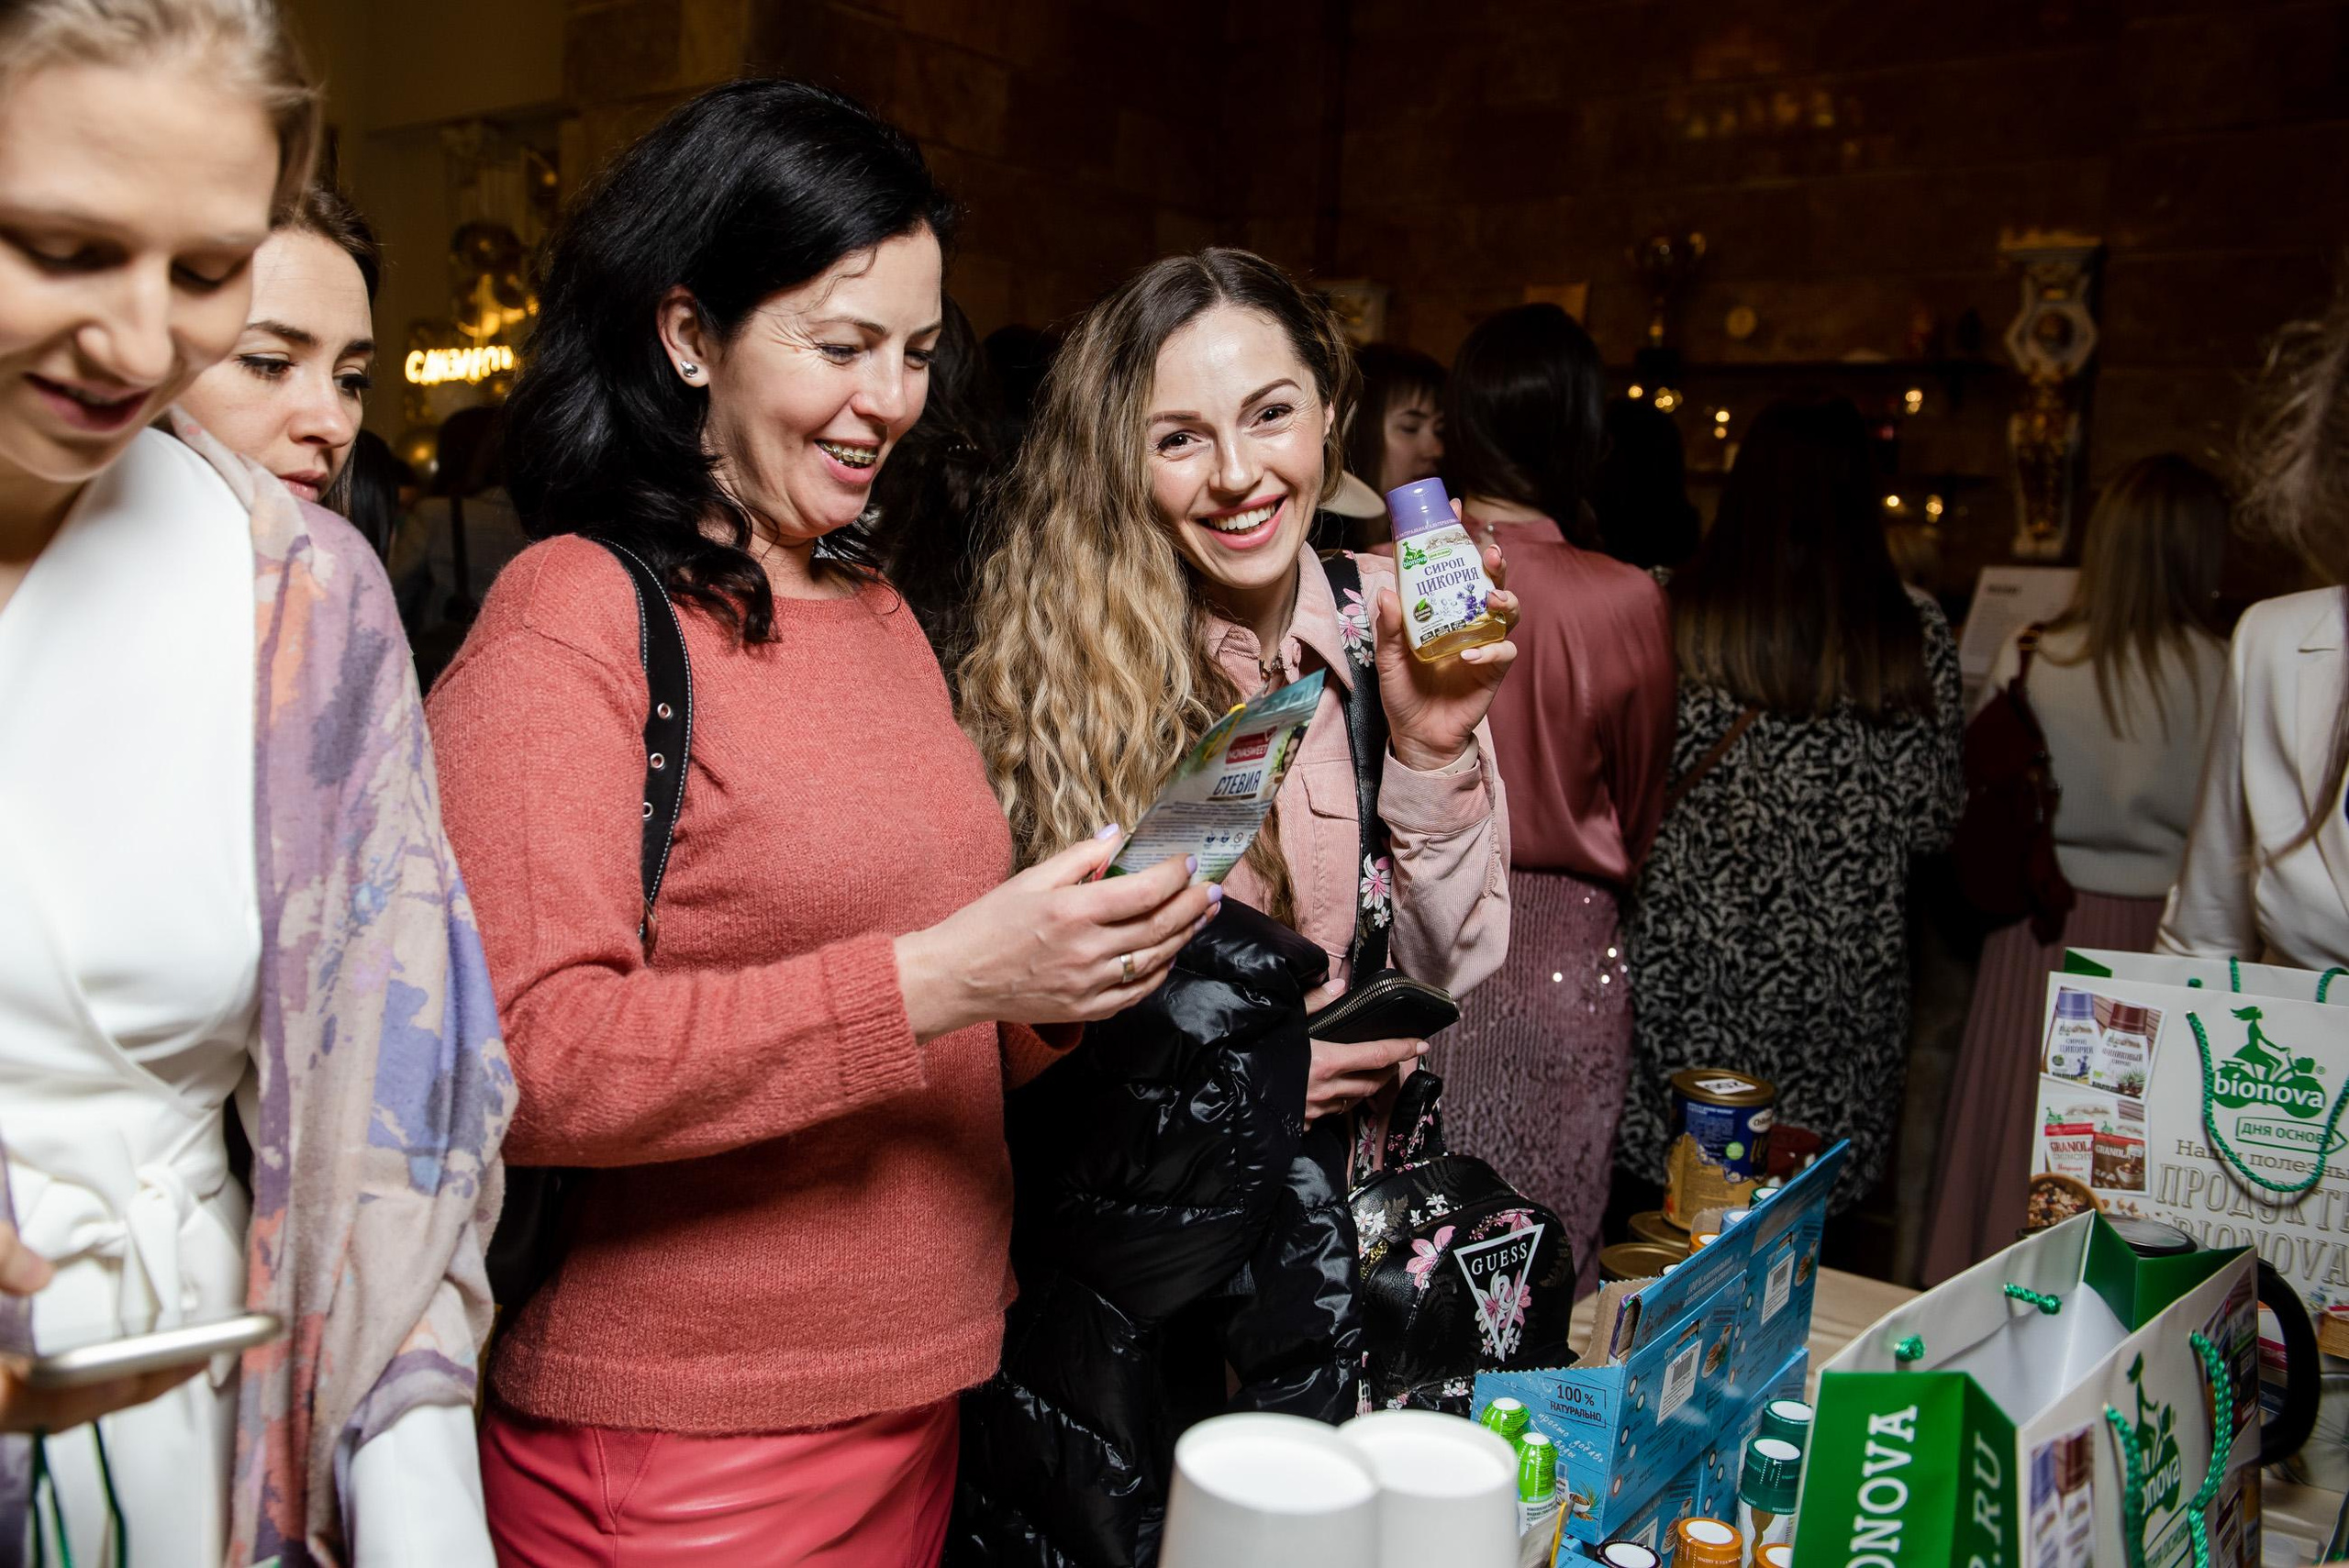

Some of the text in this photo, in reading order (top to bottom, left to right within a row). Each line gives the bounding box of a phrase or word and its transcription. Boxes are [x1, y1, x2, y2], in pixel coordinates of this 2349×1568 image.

[1402, 557, 1428, 568] bionova
[1424, 557, 1465, 576] СИРОП
[1416, 566, 1480, 596] ЦИКОРИЯ
[1213, 770, 1262, 795] СТЕВИЯ
[2059, 1044, 2094, 1055] ЦИКОРИЯ
[2214, 1071, 2325, 1110] bionova
[2242, 1122, 2273, 1137] ДНЯ
[1470, 1241, 1529, 1276] GUESS
[1550, 1400, 1602, 1422] НАТУРАЛЬНО
[1537, 1412, 1569, 1439] просто
[1569, 1440, 1604, 1463] добавь
[1553, 1439, 1576, 1459] воды
[1968, 1429, 2001, 1568] .RU
